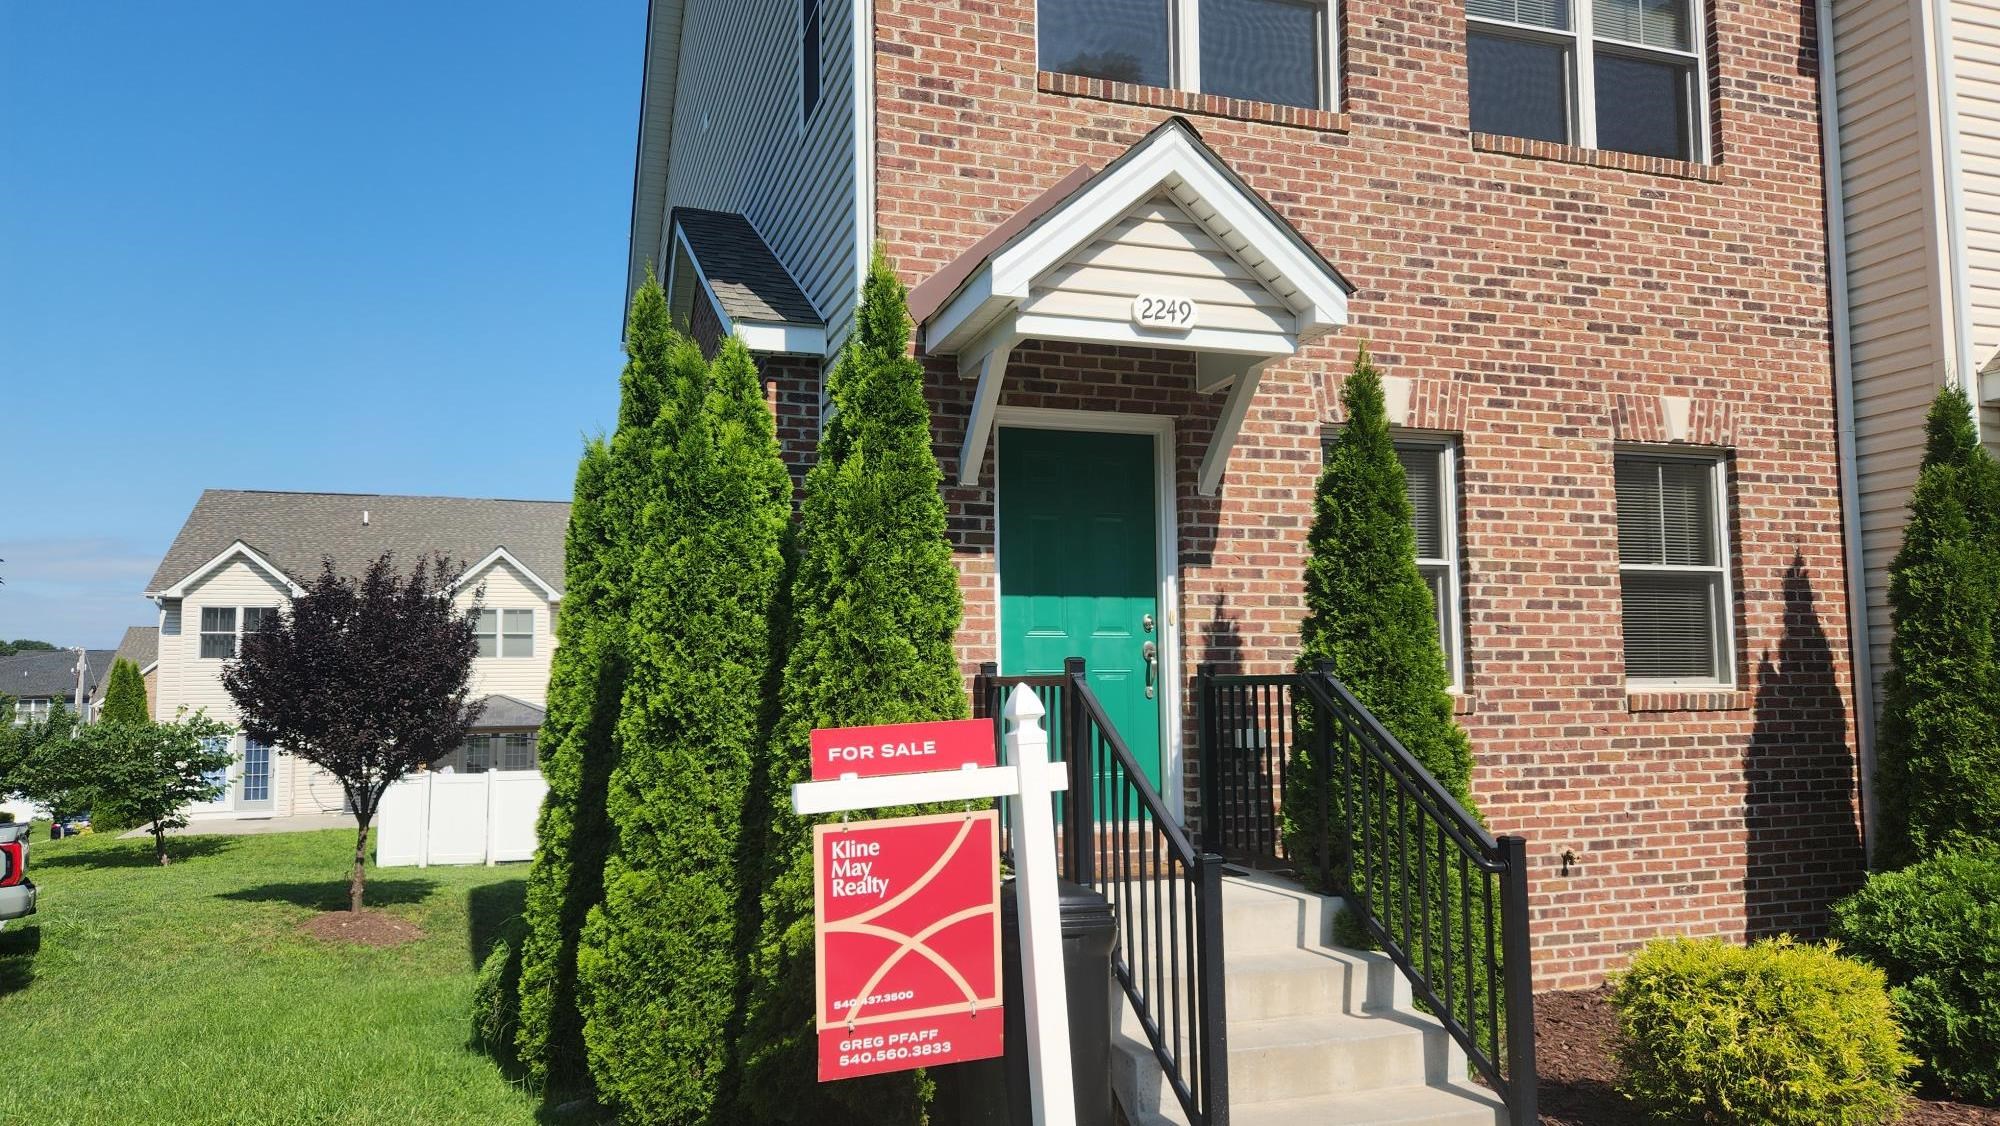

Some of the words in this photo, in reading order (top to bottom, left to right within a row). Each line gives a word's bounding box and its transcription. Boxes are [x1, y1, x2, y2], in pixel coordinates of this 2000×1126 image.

[1142, 298, 1192, 324] 2249
[828, 745, 874, 762] FOR
[881, 741, 937, 758] SALE
[831, 840, 880, 859] Kline
[831, 861, 872, 881] May
[832, 876, 889, 898] Realty
[839, 1036, 884, 1051] GREG
[888, 1029, 939, 1046] PFAFF
[839, 1042, 952, 1066] 540.560.3833
